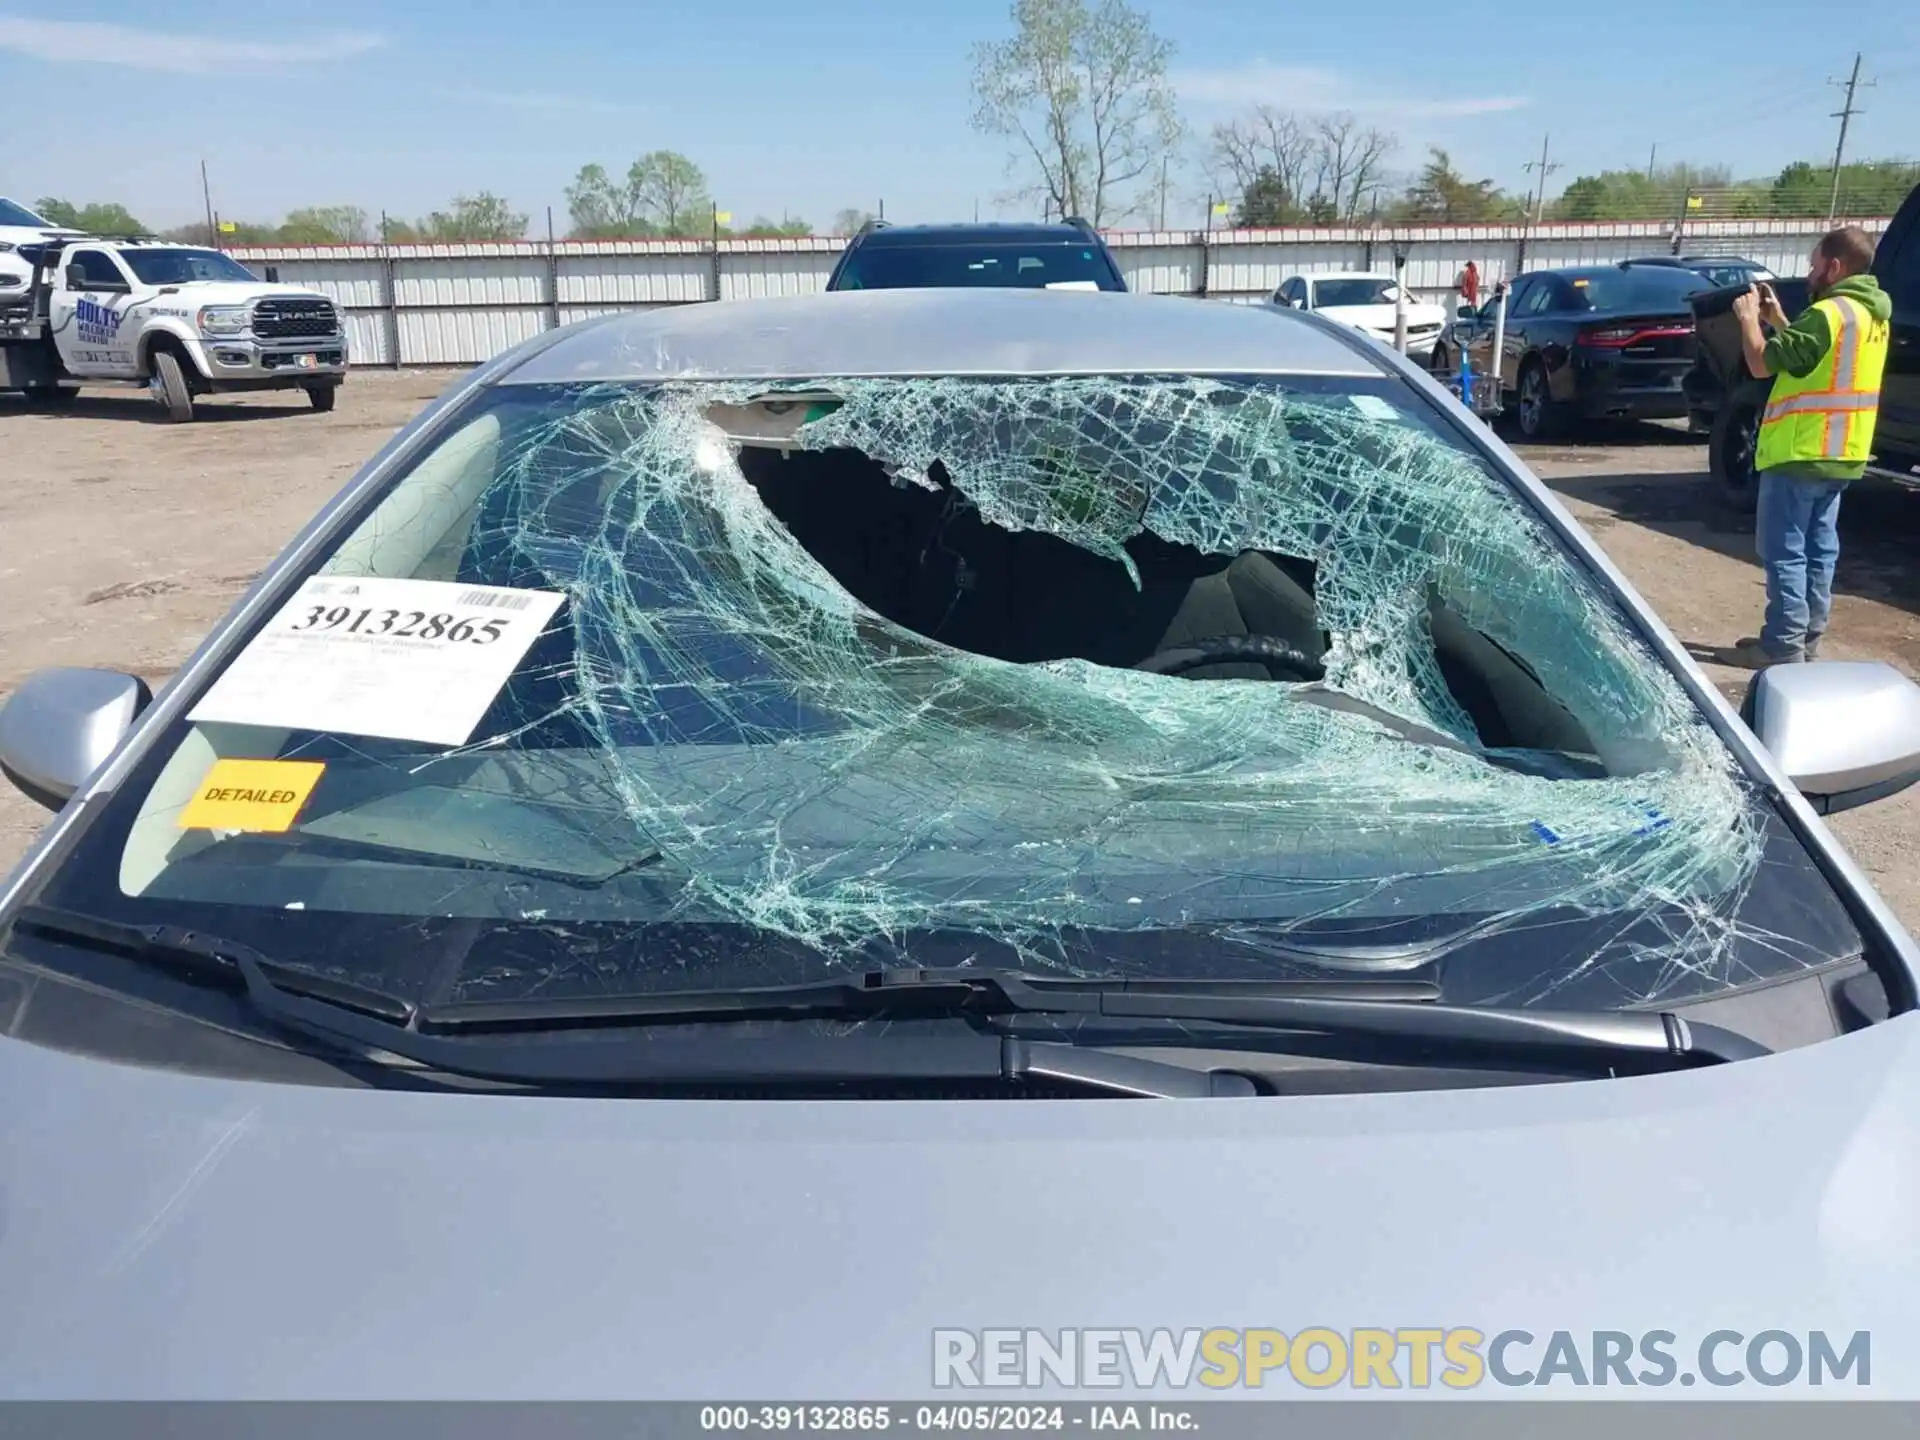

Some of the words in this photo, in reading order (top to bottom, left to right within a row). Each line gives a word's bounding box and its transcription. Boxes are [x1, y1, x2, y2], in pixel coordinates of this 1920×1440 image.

[76, 298, 120, 330] BOLTS
[280, 311, 319, 320] RAM
[291, 605, 511, 645] 39132865
[204, 787, 297, 804] DETAILED
